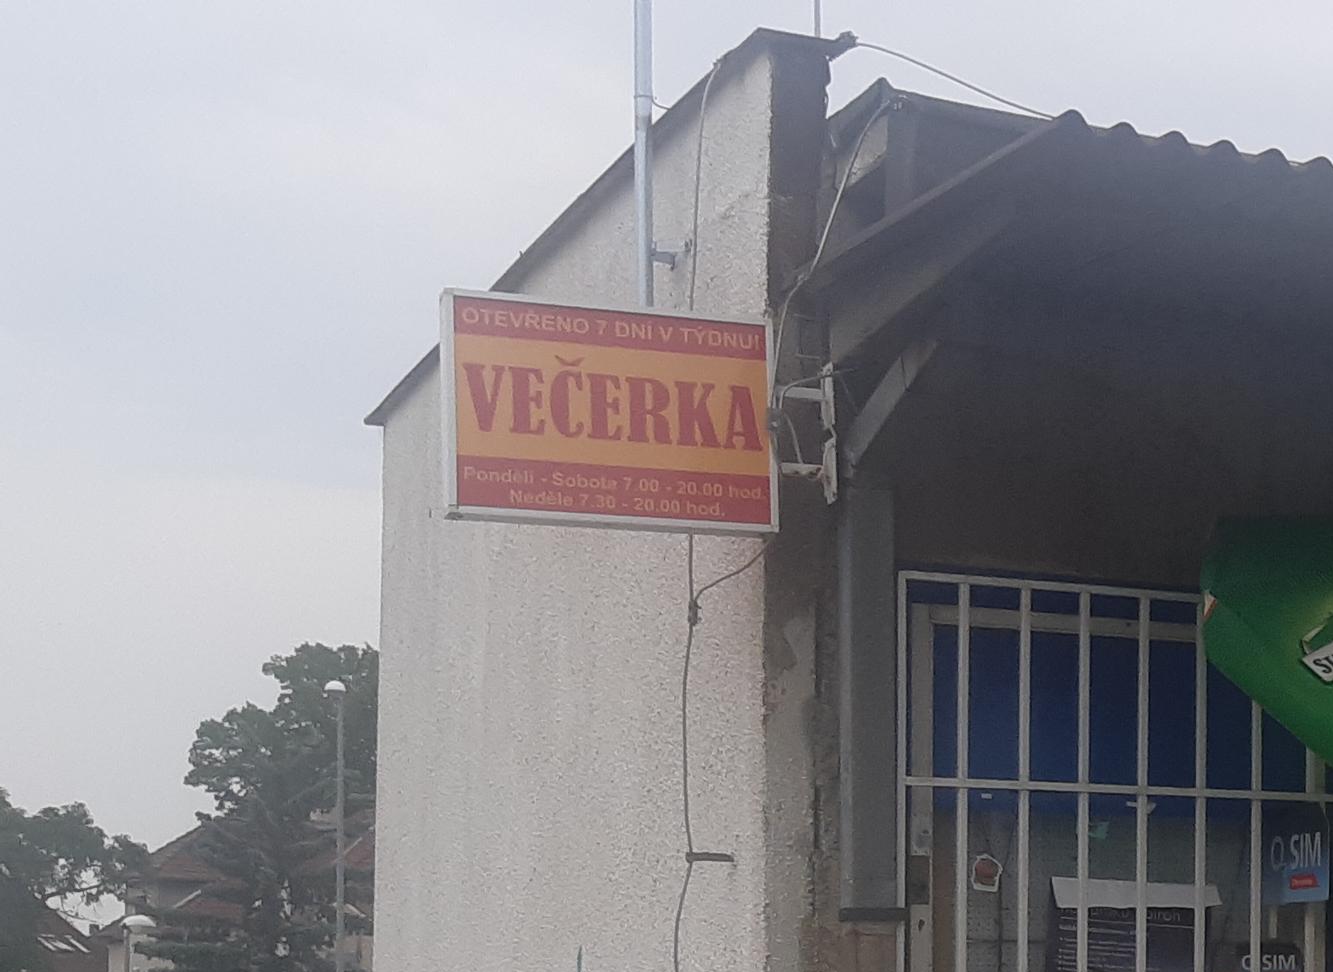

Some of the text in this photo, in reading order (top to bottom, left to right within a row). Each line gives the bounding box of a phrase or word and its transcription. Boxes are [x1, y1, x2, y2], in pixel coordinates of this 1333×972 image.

[461, 307, 590, 335] OTEVŘENO
[596, 319, 609, 336] 7
[658, 326, 673, 343] V
[681, 325, 760, 351] TÝDNU!
[462, 354, 764, 452] VEČERKA
[1290, 832, 1321, 869] SIM
[1261, 954, 1297, 970] SIM
